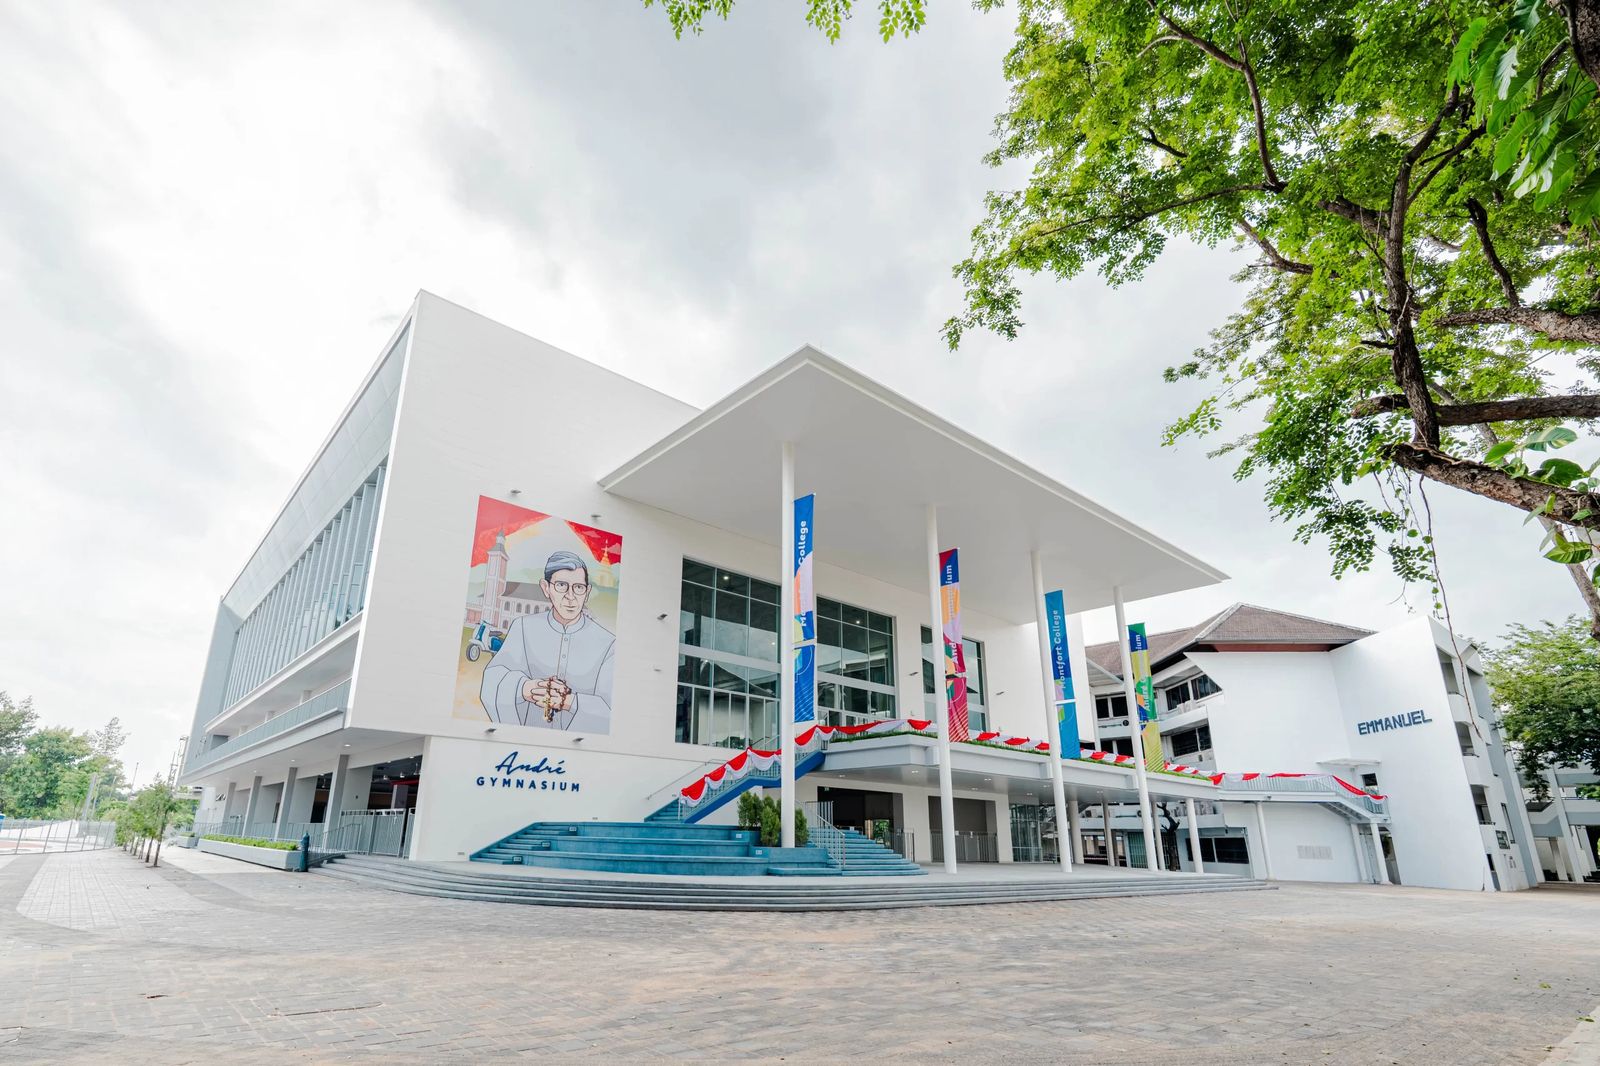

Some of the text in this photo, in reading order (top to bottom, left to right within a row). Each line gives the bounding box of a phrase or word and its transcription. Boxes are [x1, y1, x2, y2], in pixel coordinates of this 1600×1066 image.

[798, 520, 808, 566] College
[1053, 610, 1062, 644] College
[1357, 709, 1432, 735] EMMANUEL
[495, 751, 566, 775] André
[476, 776, 580, 792] GYMNASIUM
